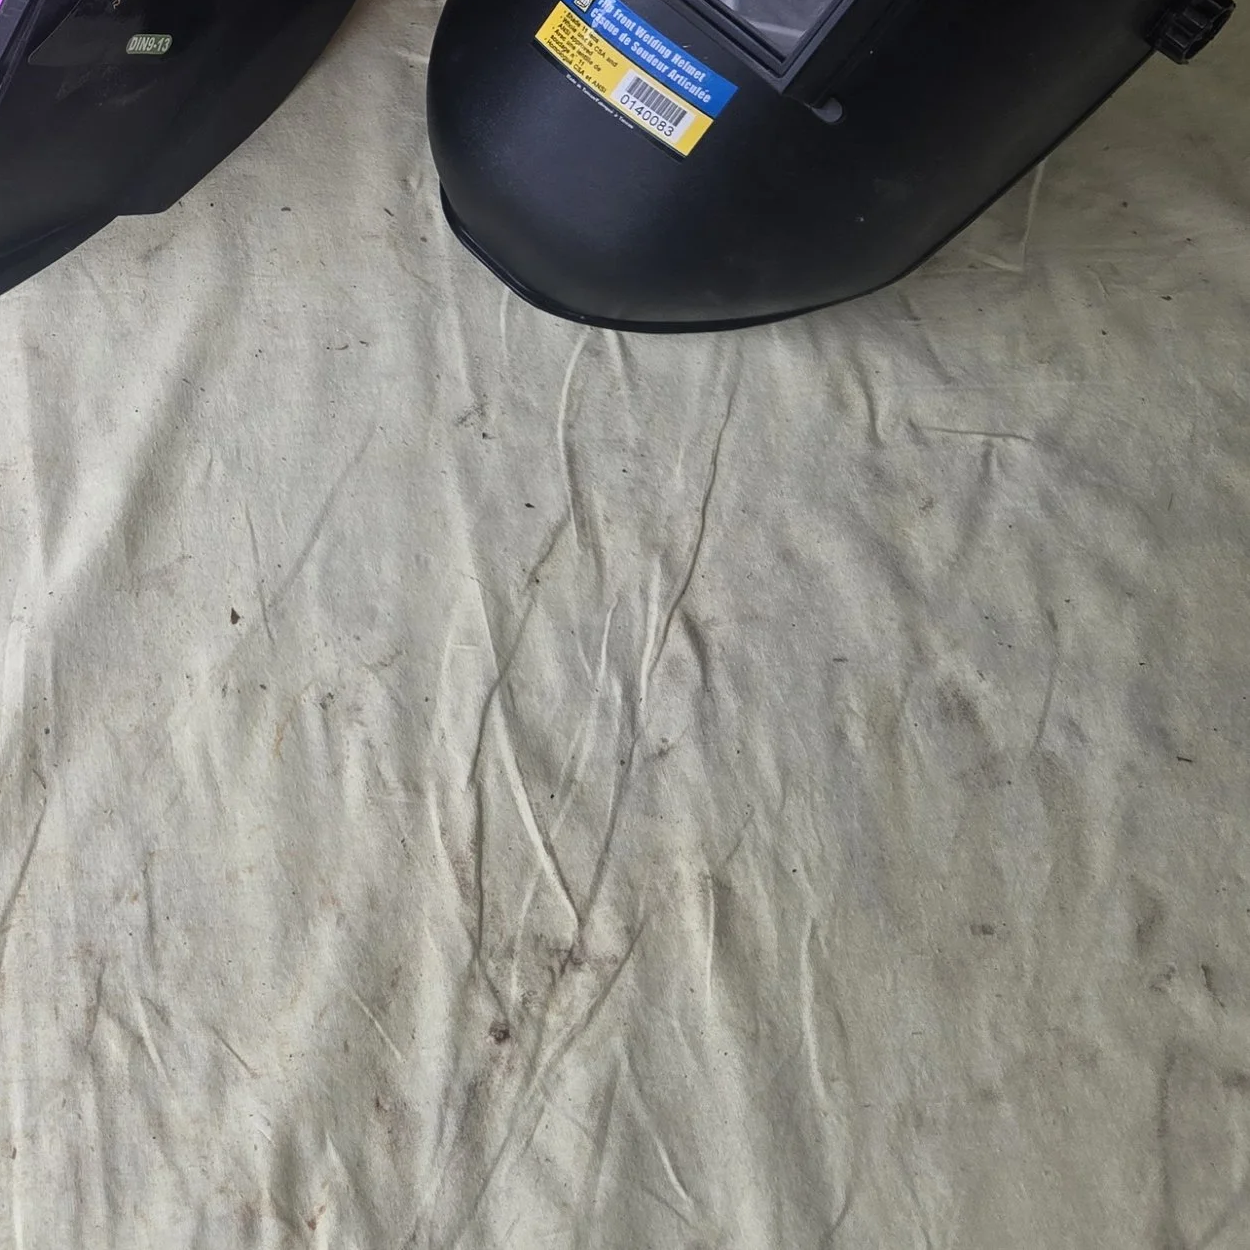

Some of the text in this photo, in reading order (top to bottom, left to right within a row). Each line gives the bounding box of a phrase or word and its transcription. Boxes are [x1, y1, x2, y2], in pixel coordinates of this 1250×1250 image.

[589, 7, 713, 104] Casque de Soudeur Articulée
[593, 45, 606, 58] CSA
[612, 8, 636, 30] Front
[633, 25, 672, 59] Welding
[670, 52, 706, 82] Helmet
[572, 63, 585, 75] CSA
[619, 93, 674, 137] 0140083
